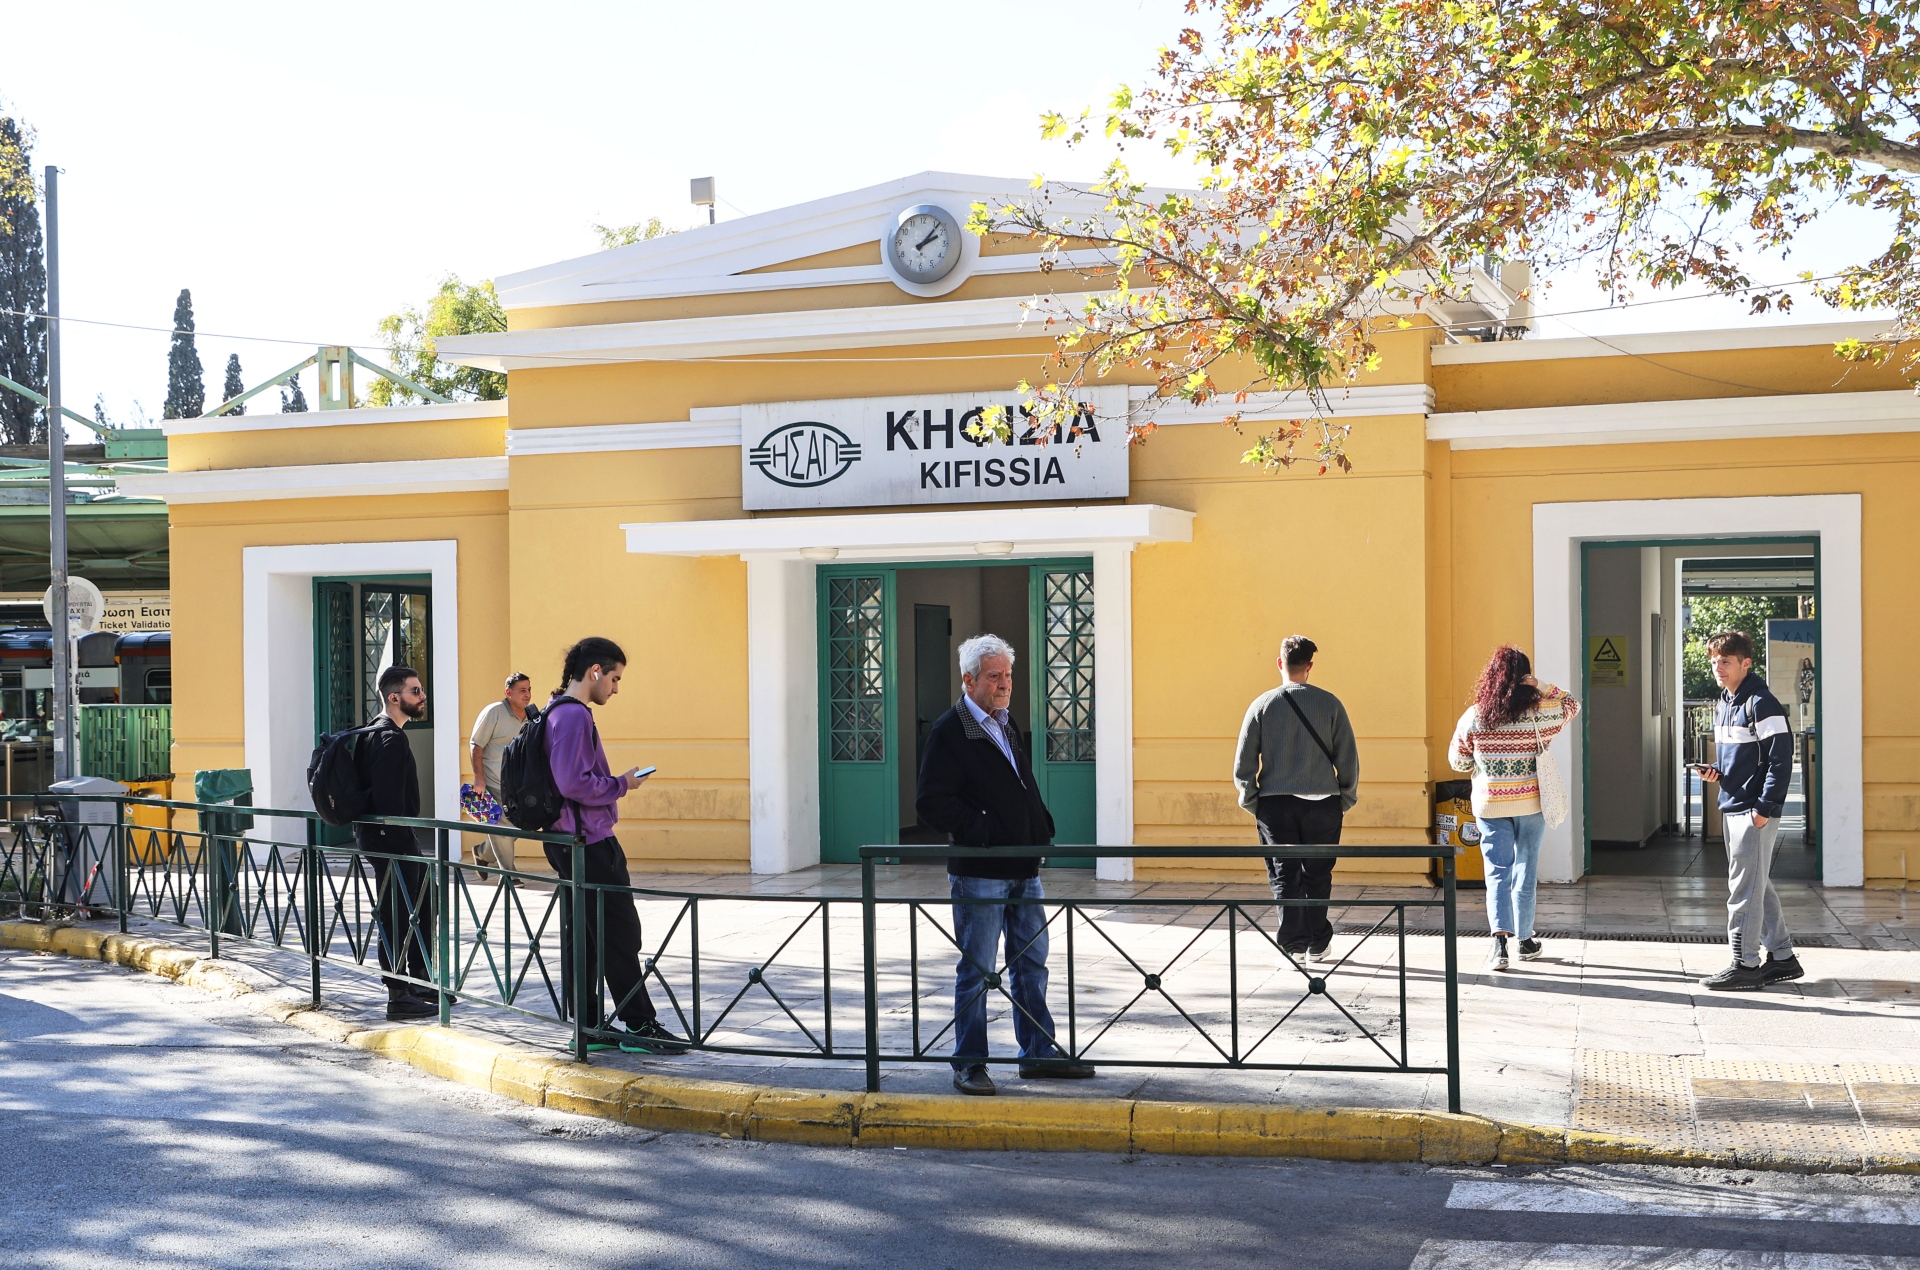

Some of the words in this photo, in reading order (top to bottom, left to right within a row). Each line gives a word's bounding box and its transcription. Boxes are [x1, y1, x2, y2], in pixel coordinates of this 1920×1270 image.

[772, 429, 839, 480] ΗΣΑΠ
[920, 456, 1066, 489] KIFISSIA
[99, 621, 128, 629] Ticket
[131, 620, 170, 629] Validatio
